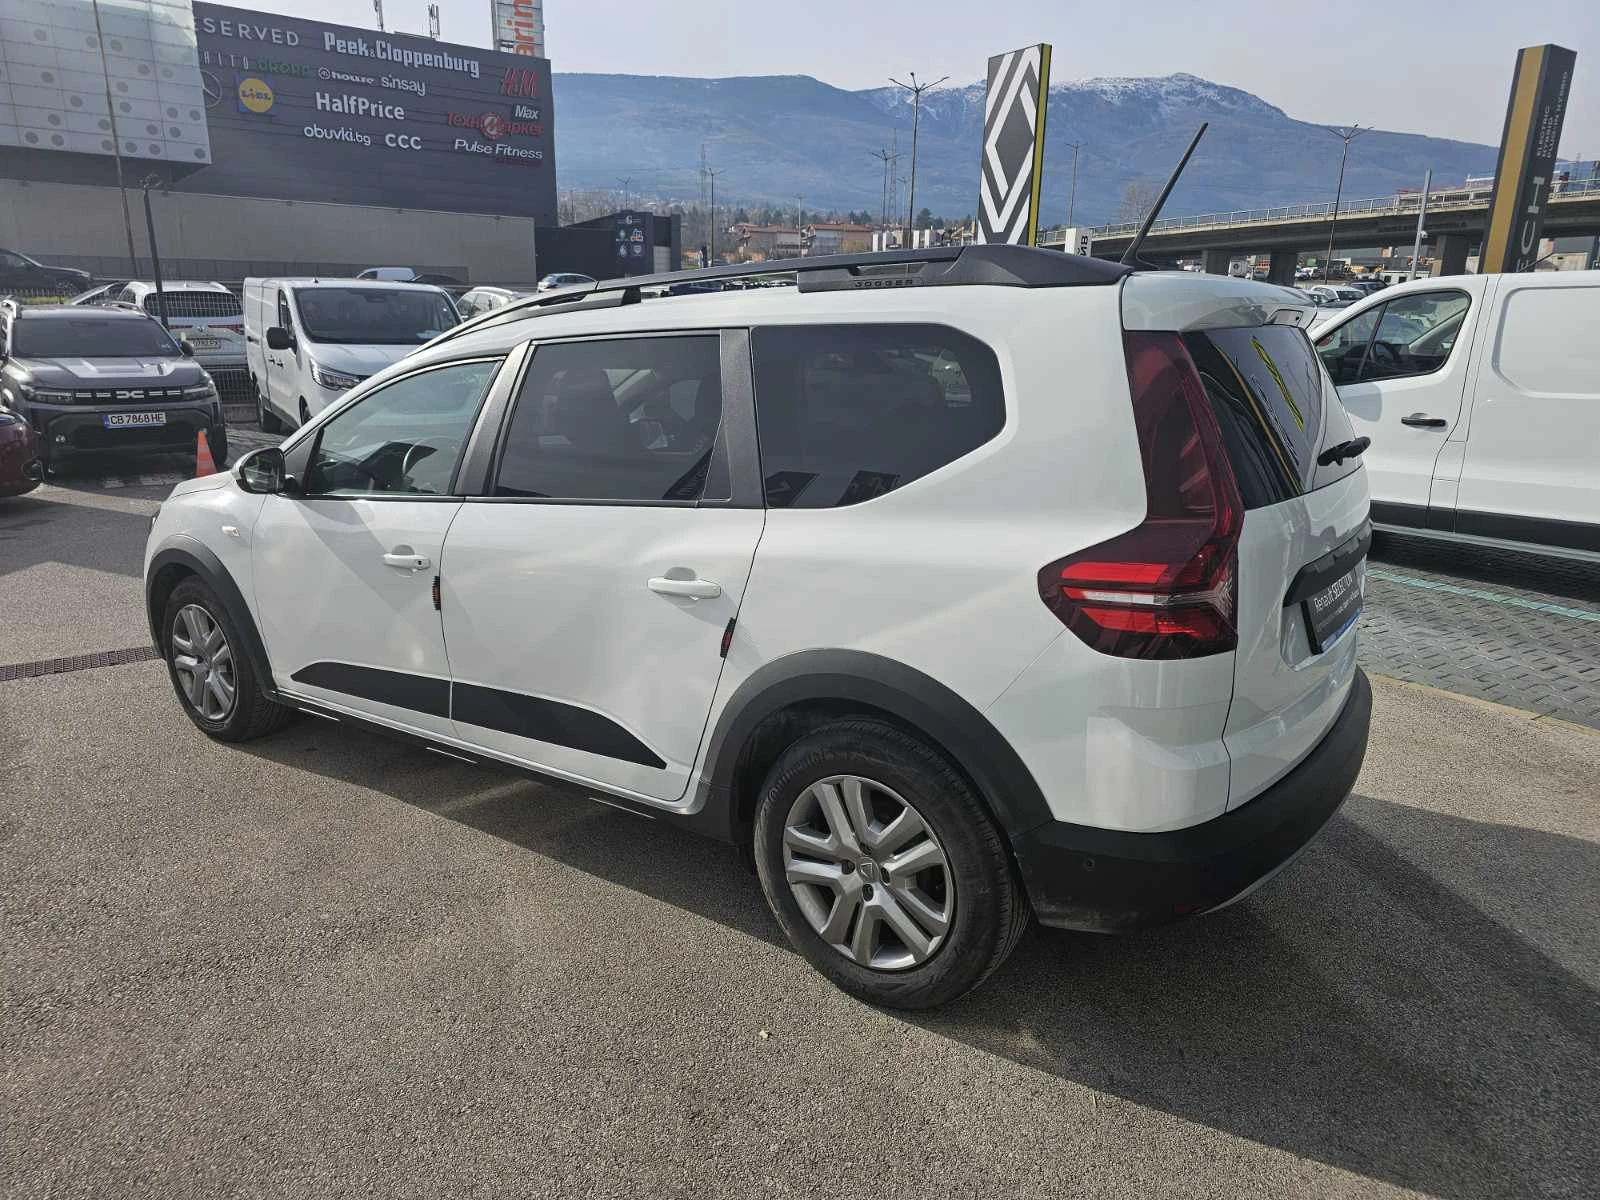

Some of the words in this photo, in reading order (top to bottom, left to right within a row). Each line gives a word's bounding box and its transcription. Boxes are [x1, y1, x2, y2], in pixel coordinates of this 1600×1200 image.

[381, 74, 426, 96] sinsay
[315, 91, 405, 120] HalfPrice
[515, 104, 540, 119] Max
[303, 124, 371, 146] obuvki.bg
[454, 138, 493, 155] Pulse
[495, 143, 543, 160] Fitness
